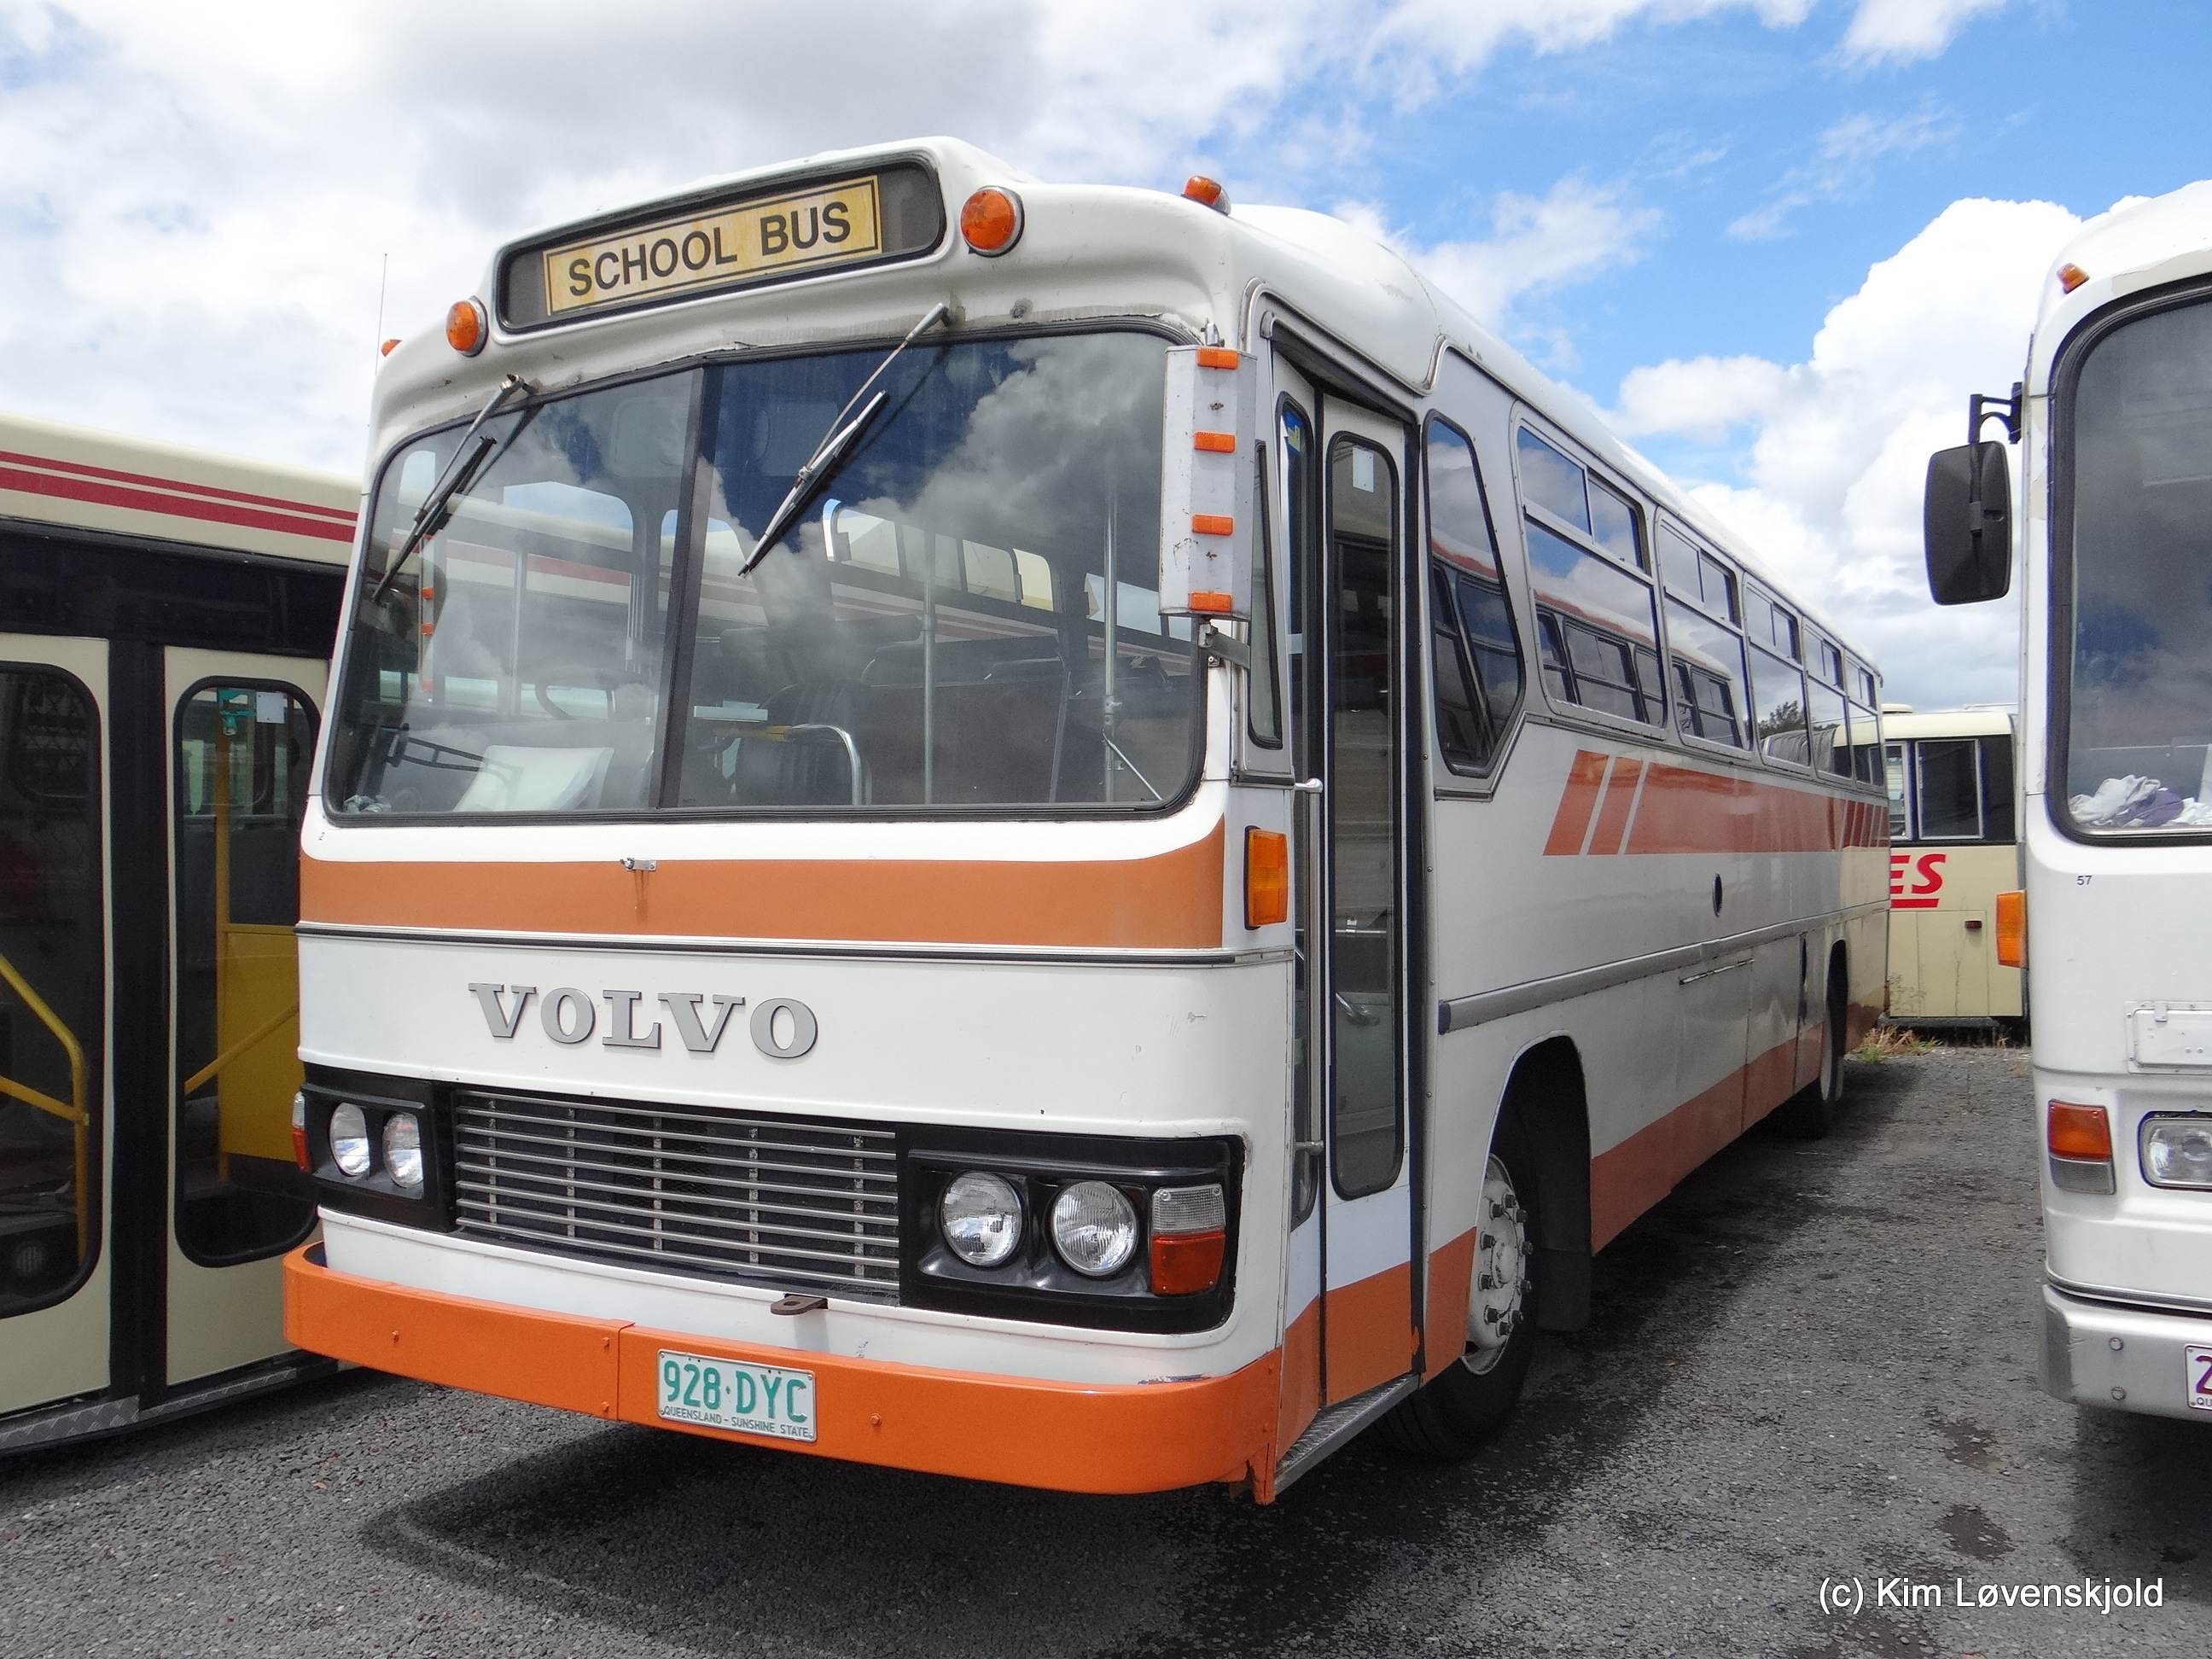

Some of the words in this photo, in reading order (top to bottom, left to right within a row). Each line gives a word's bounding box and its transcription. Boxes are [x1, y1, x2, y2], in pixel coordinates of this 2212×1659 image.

[568, 227, 737, 296] SCHOOL
[760, 201, 851, 256] BUS
[1890, 853, 1946, 894] ES
[2076, 875, 2093, 886] 57
[468, 982, 818, 1058] VOLVO
[664, 1406, 722, 1423] QUEENSLAND
[731, 1416, 776, 1433] SUNSHINE
[780, 1424, 809, 1438] STATE
